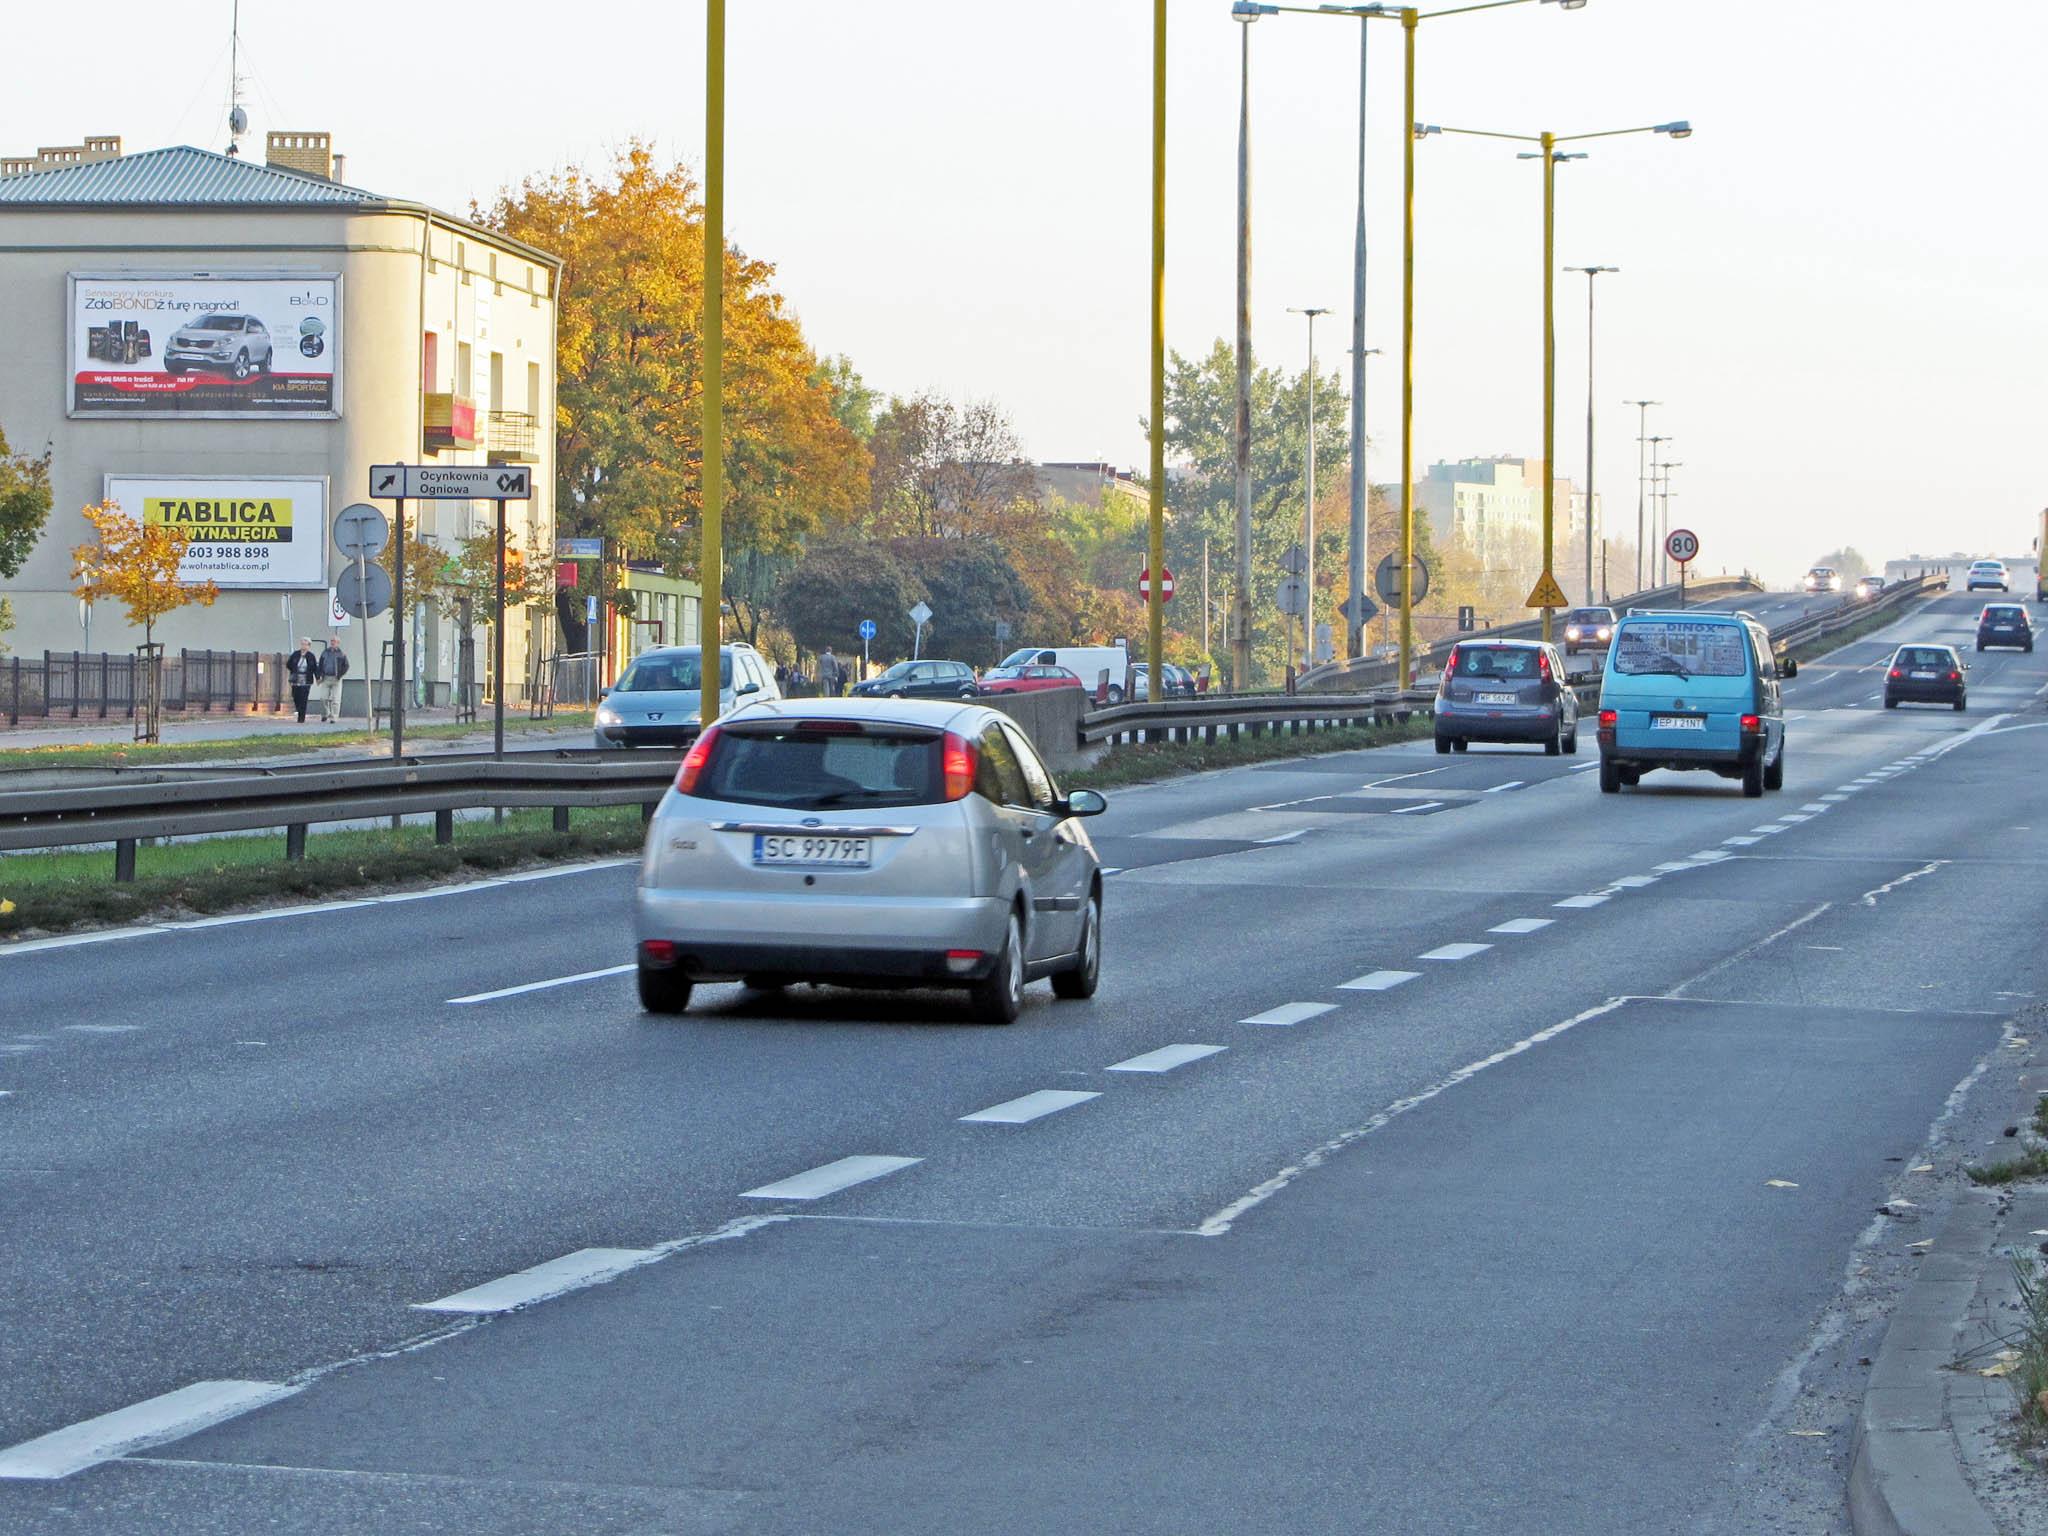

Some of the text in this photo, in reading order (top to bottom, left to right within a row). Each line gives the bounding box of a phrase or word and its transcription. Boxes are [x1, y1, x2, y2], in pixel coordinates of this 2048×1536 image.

[137, 289, 175, 297] Konkurs
[168, 300, 191, 312] furę
[272, 383, 328, 392] KIA SPORTAGE
[420, 471, 489, 483] Ocynkownia
[420, 484, 469, 496] Ogniowa
[159, 501, 276, 522] TABLICA
[185, 526, 278, 542] WYNAJĘCIA
[1672, 537, 1694, 553] 80
[188, 547, 213, 558] 603
[216, 547, 241, 558] 988
[244, 547, 270, 558] 898
[178, 562, 270, 572] w.wolnatablica.com.pl
[1680, 718, 1701, 728] 21NT
[765, 838, 867, 859] SC 9979F
